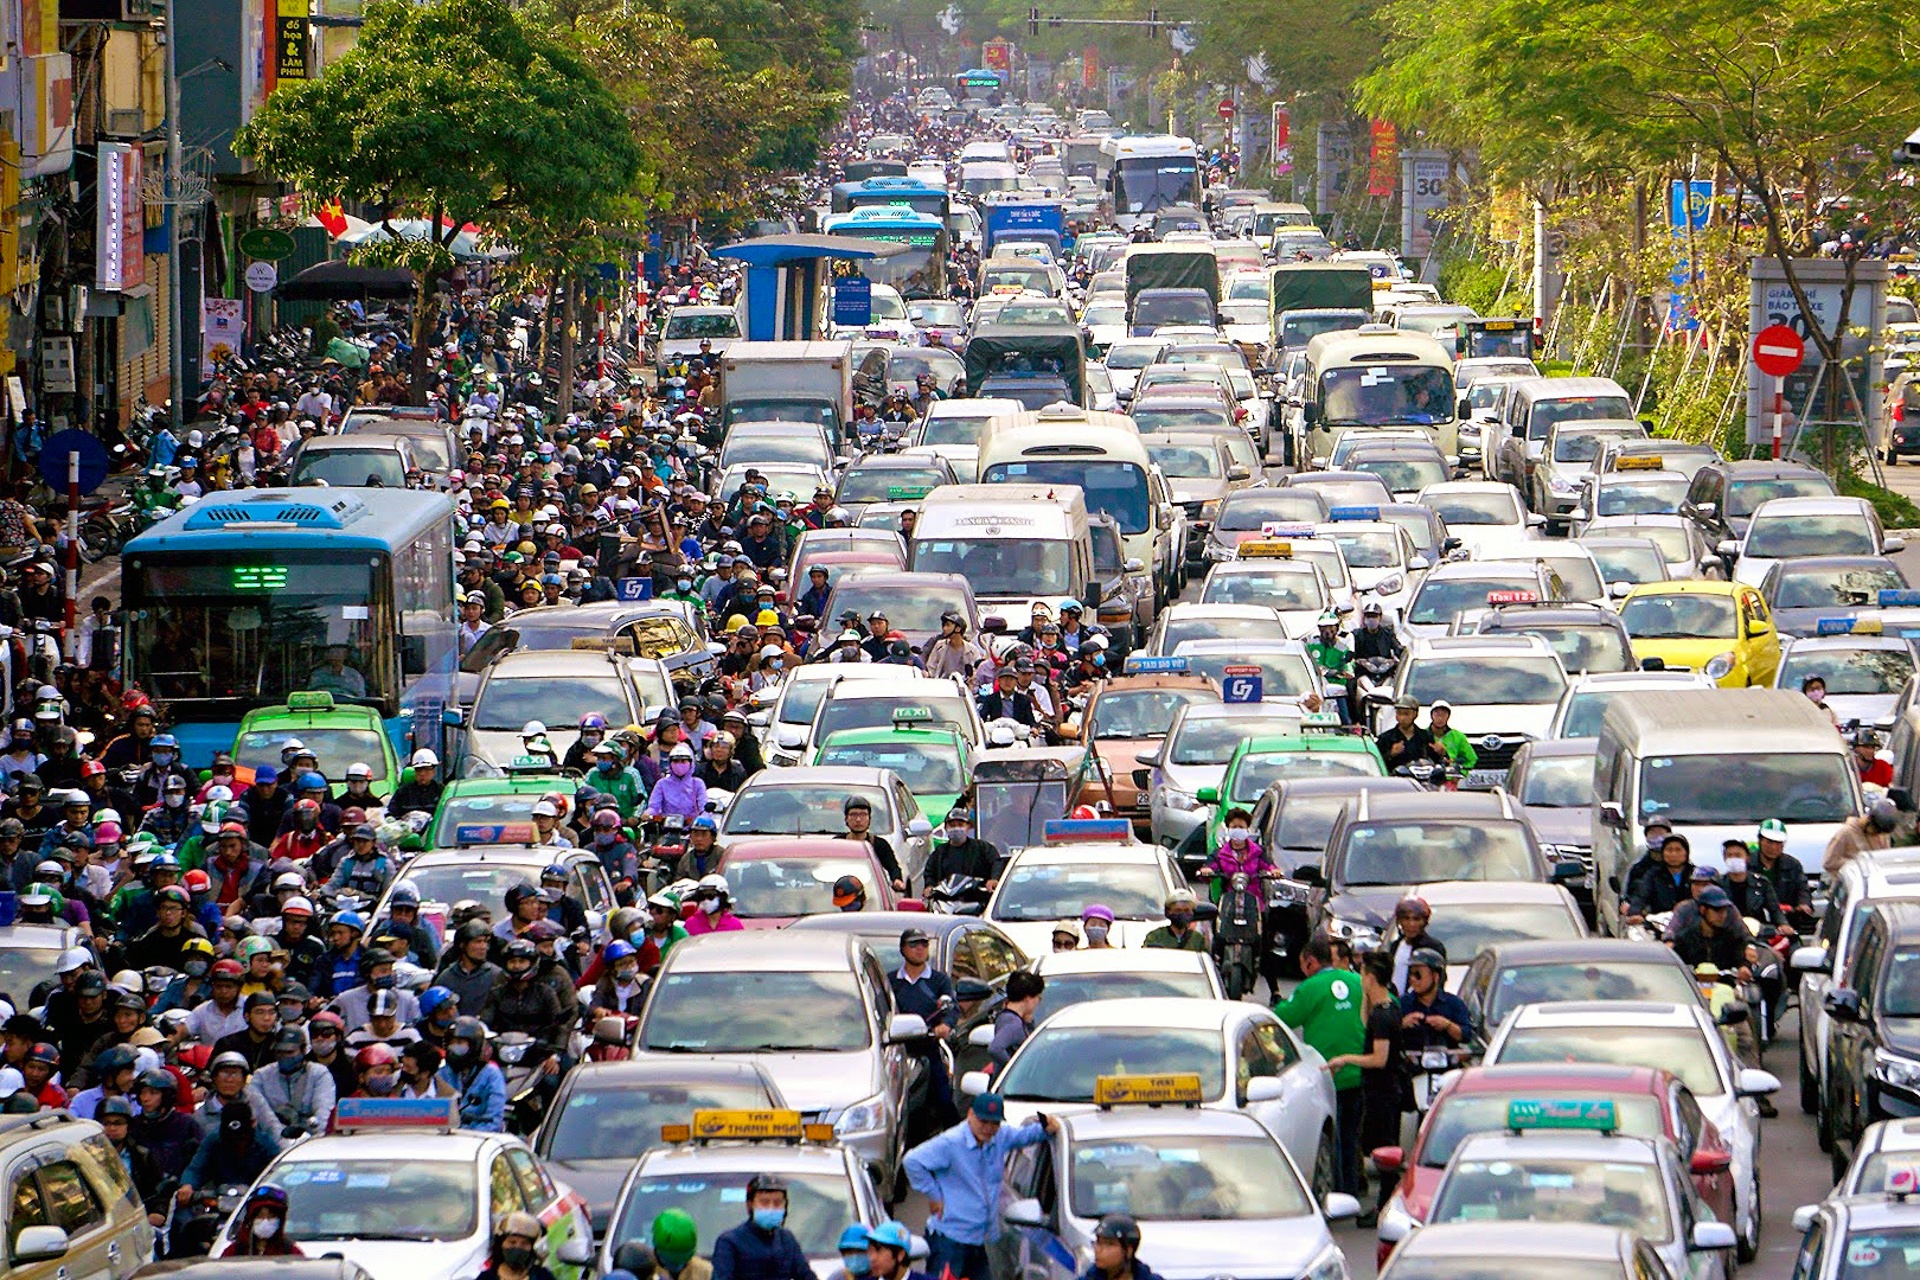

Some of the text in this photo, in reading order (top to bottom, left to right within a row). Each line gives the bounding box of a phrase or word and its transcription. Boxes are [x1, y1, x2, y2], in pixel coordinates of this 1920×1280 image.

[286, 42, 299, 57] &
[280, 68, 304, 77] PHIM
[1417, 178, 1441, 196] 30
[625, 580, 643, 598] G7
[1491, 592, 1537, 601] Taxi 123
[1143, 661, 1157, 669] TAXI
[1232, 679, 1253, 700] G7
[896, 709, 927, 717] TAXI
[514, 756, 546, 765] TAXI
[748, 1112, 773, 1120] TAXI
[728, 1124, 798, 1133] THANH NGA
